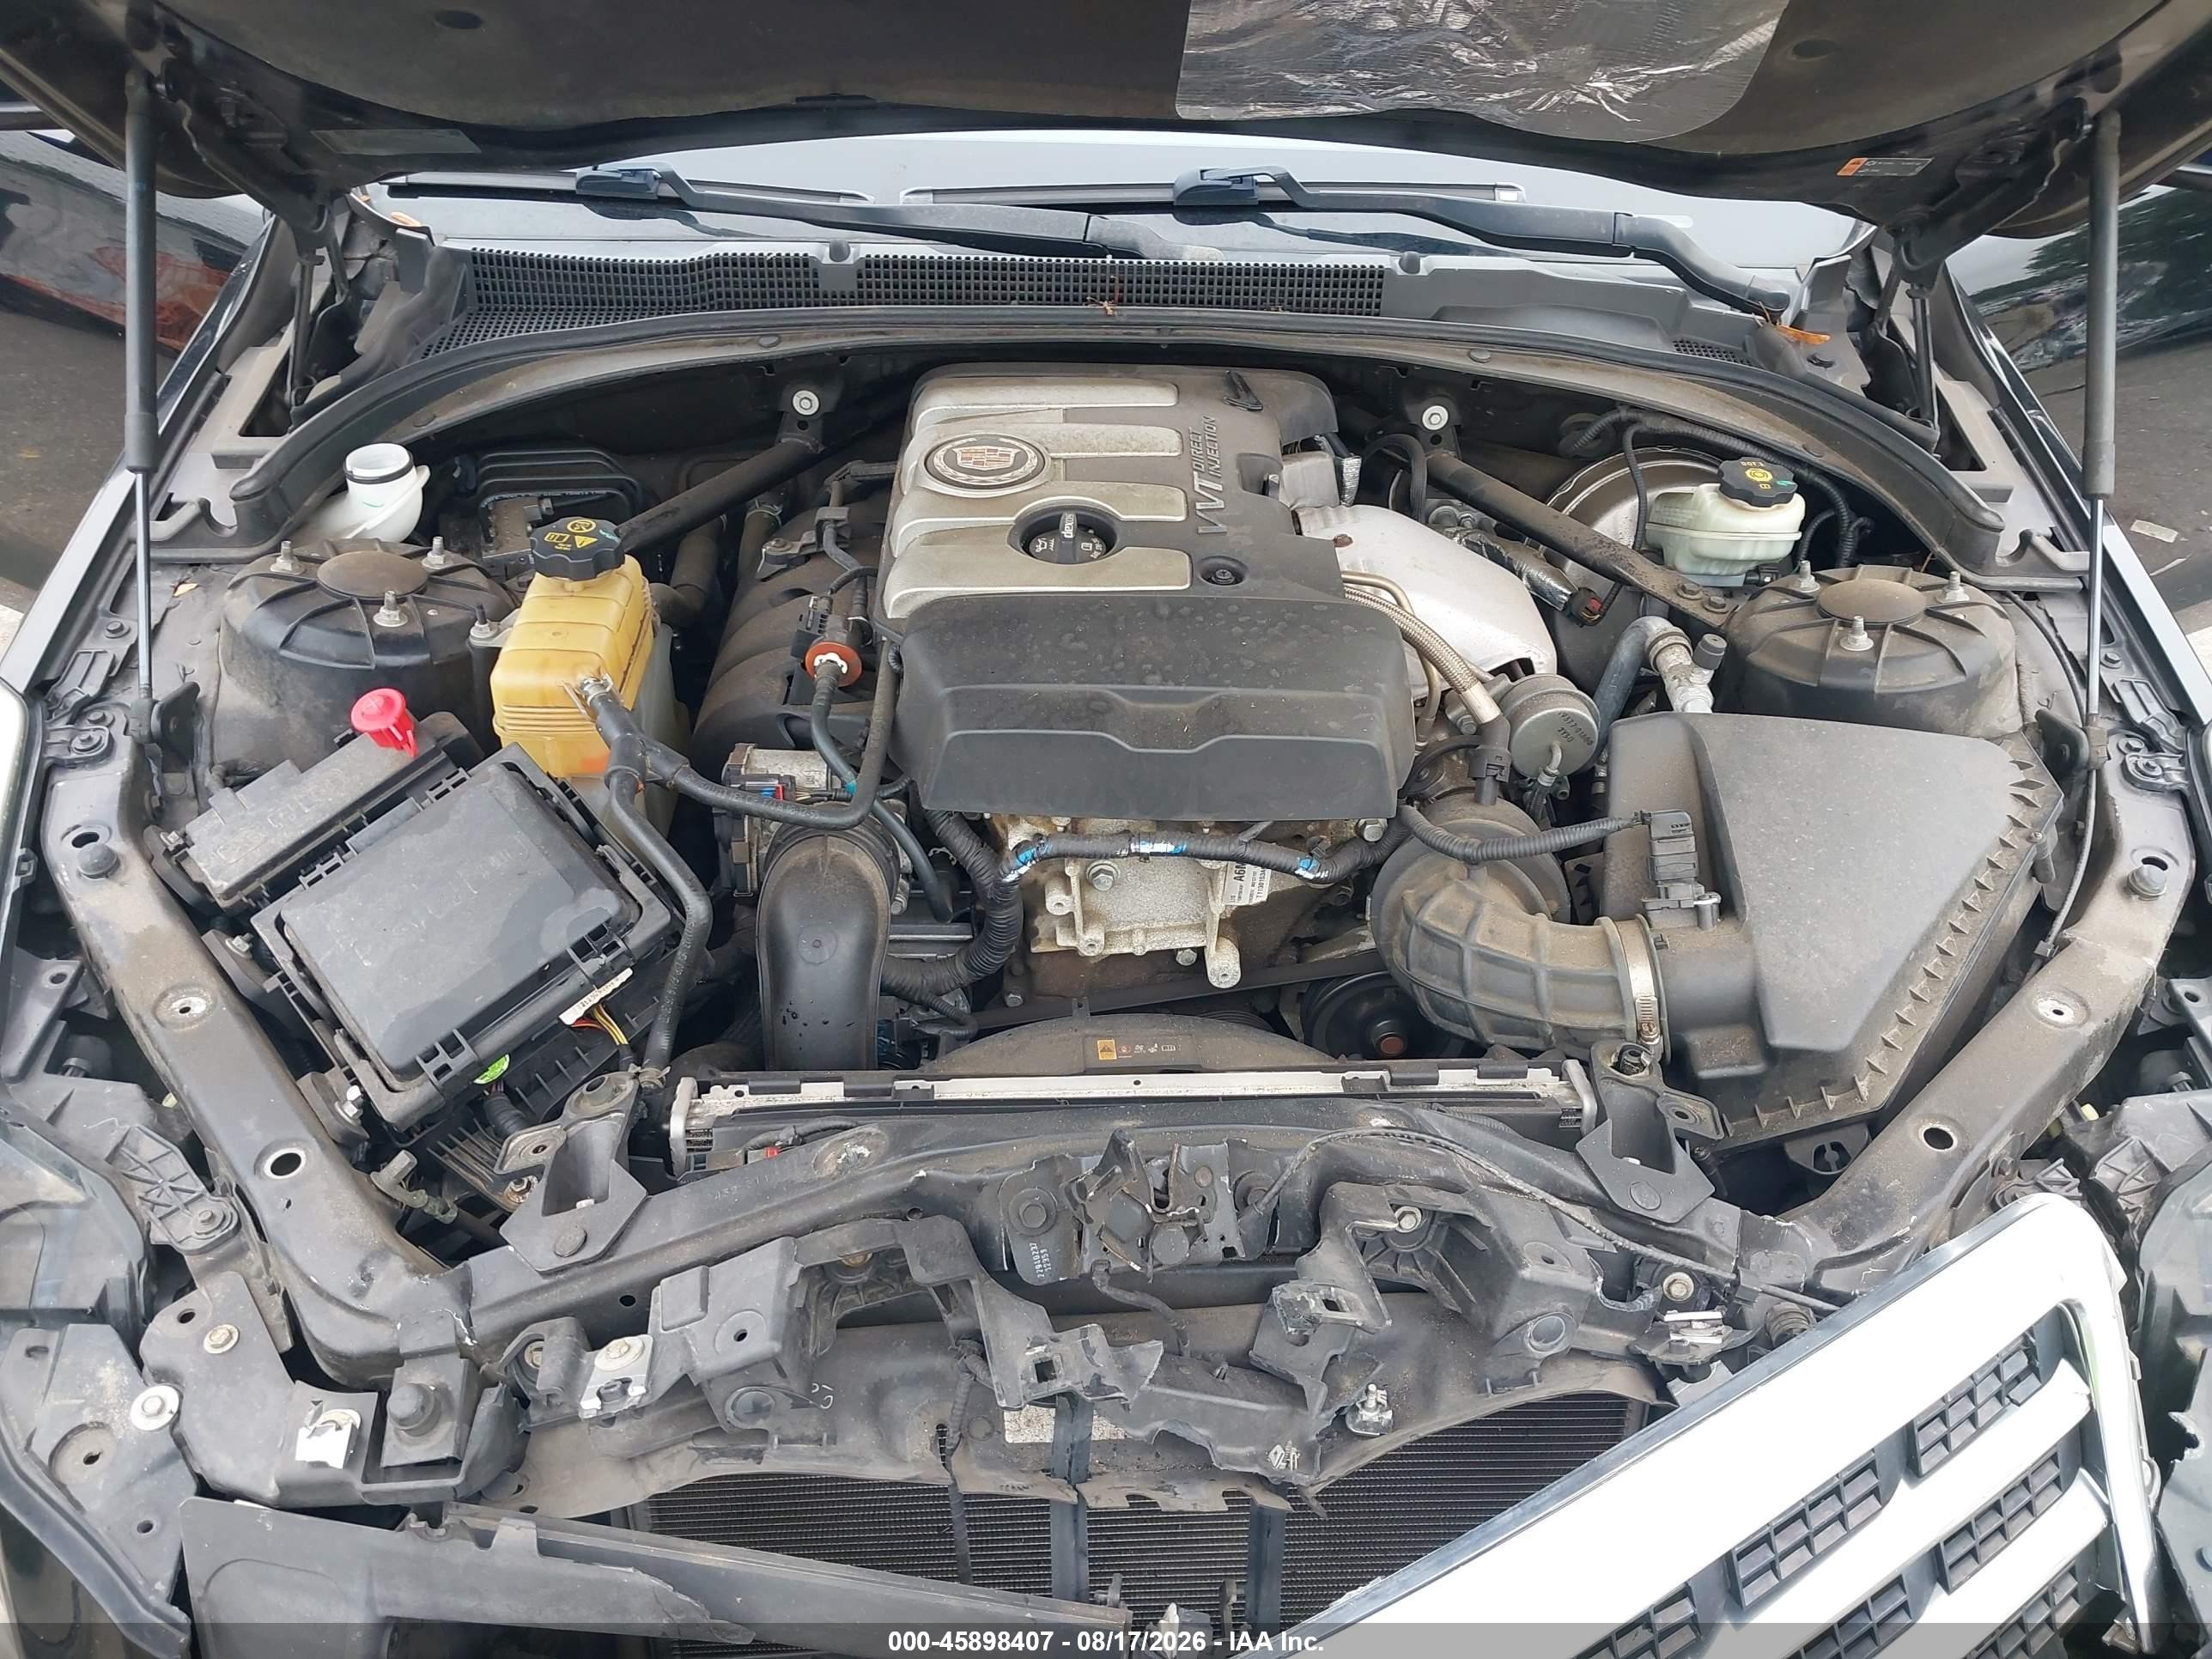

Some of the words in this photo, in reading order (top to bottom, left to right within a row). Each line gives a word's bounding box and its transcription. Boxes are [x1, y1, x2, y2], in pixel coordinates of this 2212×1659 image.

[1188, 426, 1205, 472] DIRECT
[1202, 415, 1222, 477] INJECTION
[1061, 514, 1074, 538] dexos
[1194, 471, 1227, 534] VVT
